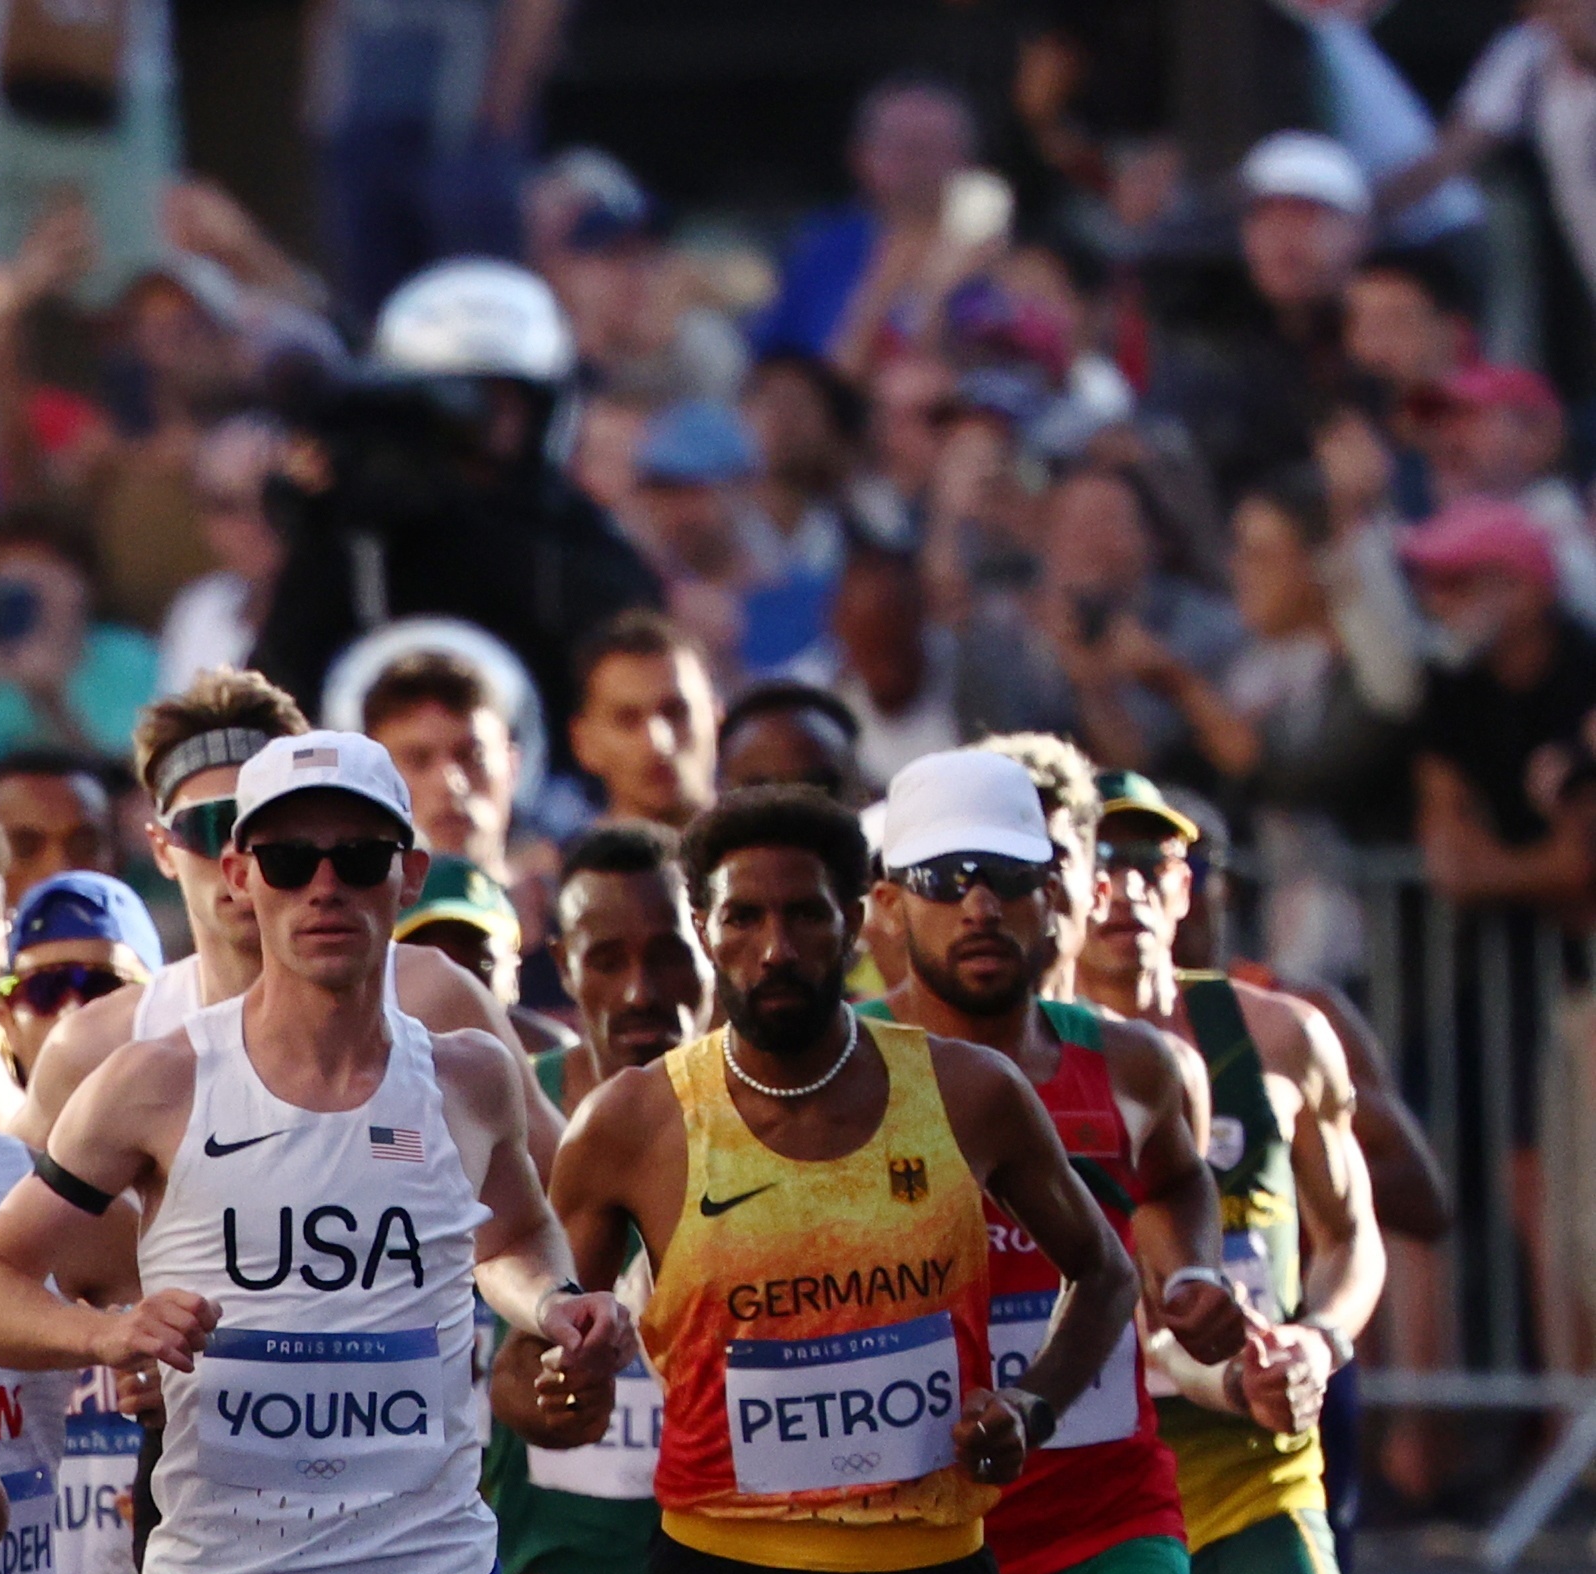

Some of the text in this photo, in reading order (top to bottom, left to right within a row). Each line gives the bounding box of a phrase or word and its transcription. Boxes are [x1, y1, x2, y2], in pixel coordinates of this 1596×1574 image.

[222, 1204, 425, 1292] USA
[727, 1258, 954, 1322] GERMANY
[266, 1339, 387, 1355] PARIS 2024
[782, 1332, 901, 1361] PARIS 2024
[217, 1389, 428, 1440] YOUNG
[738, 1369, 953, 1444] PETROS
